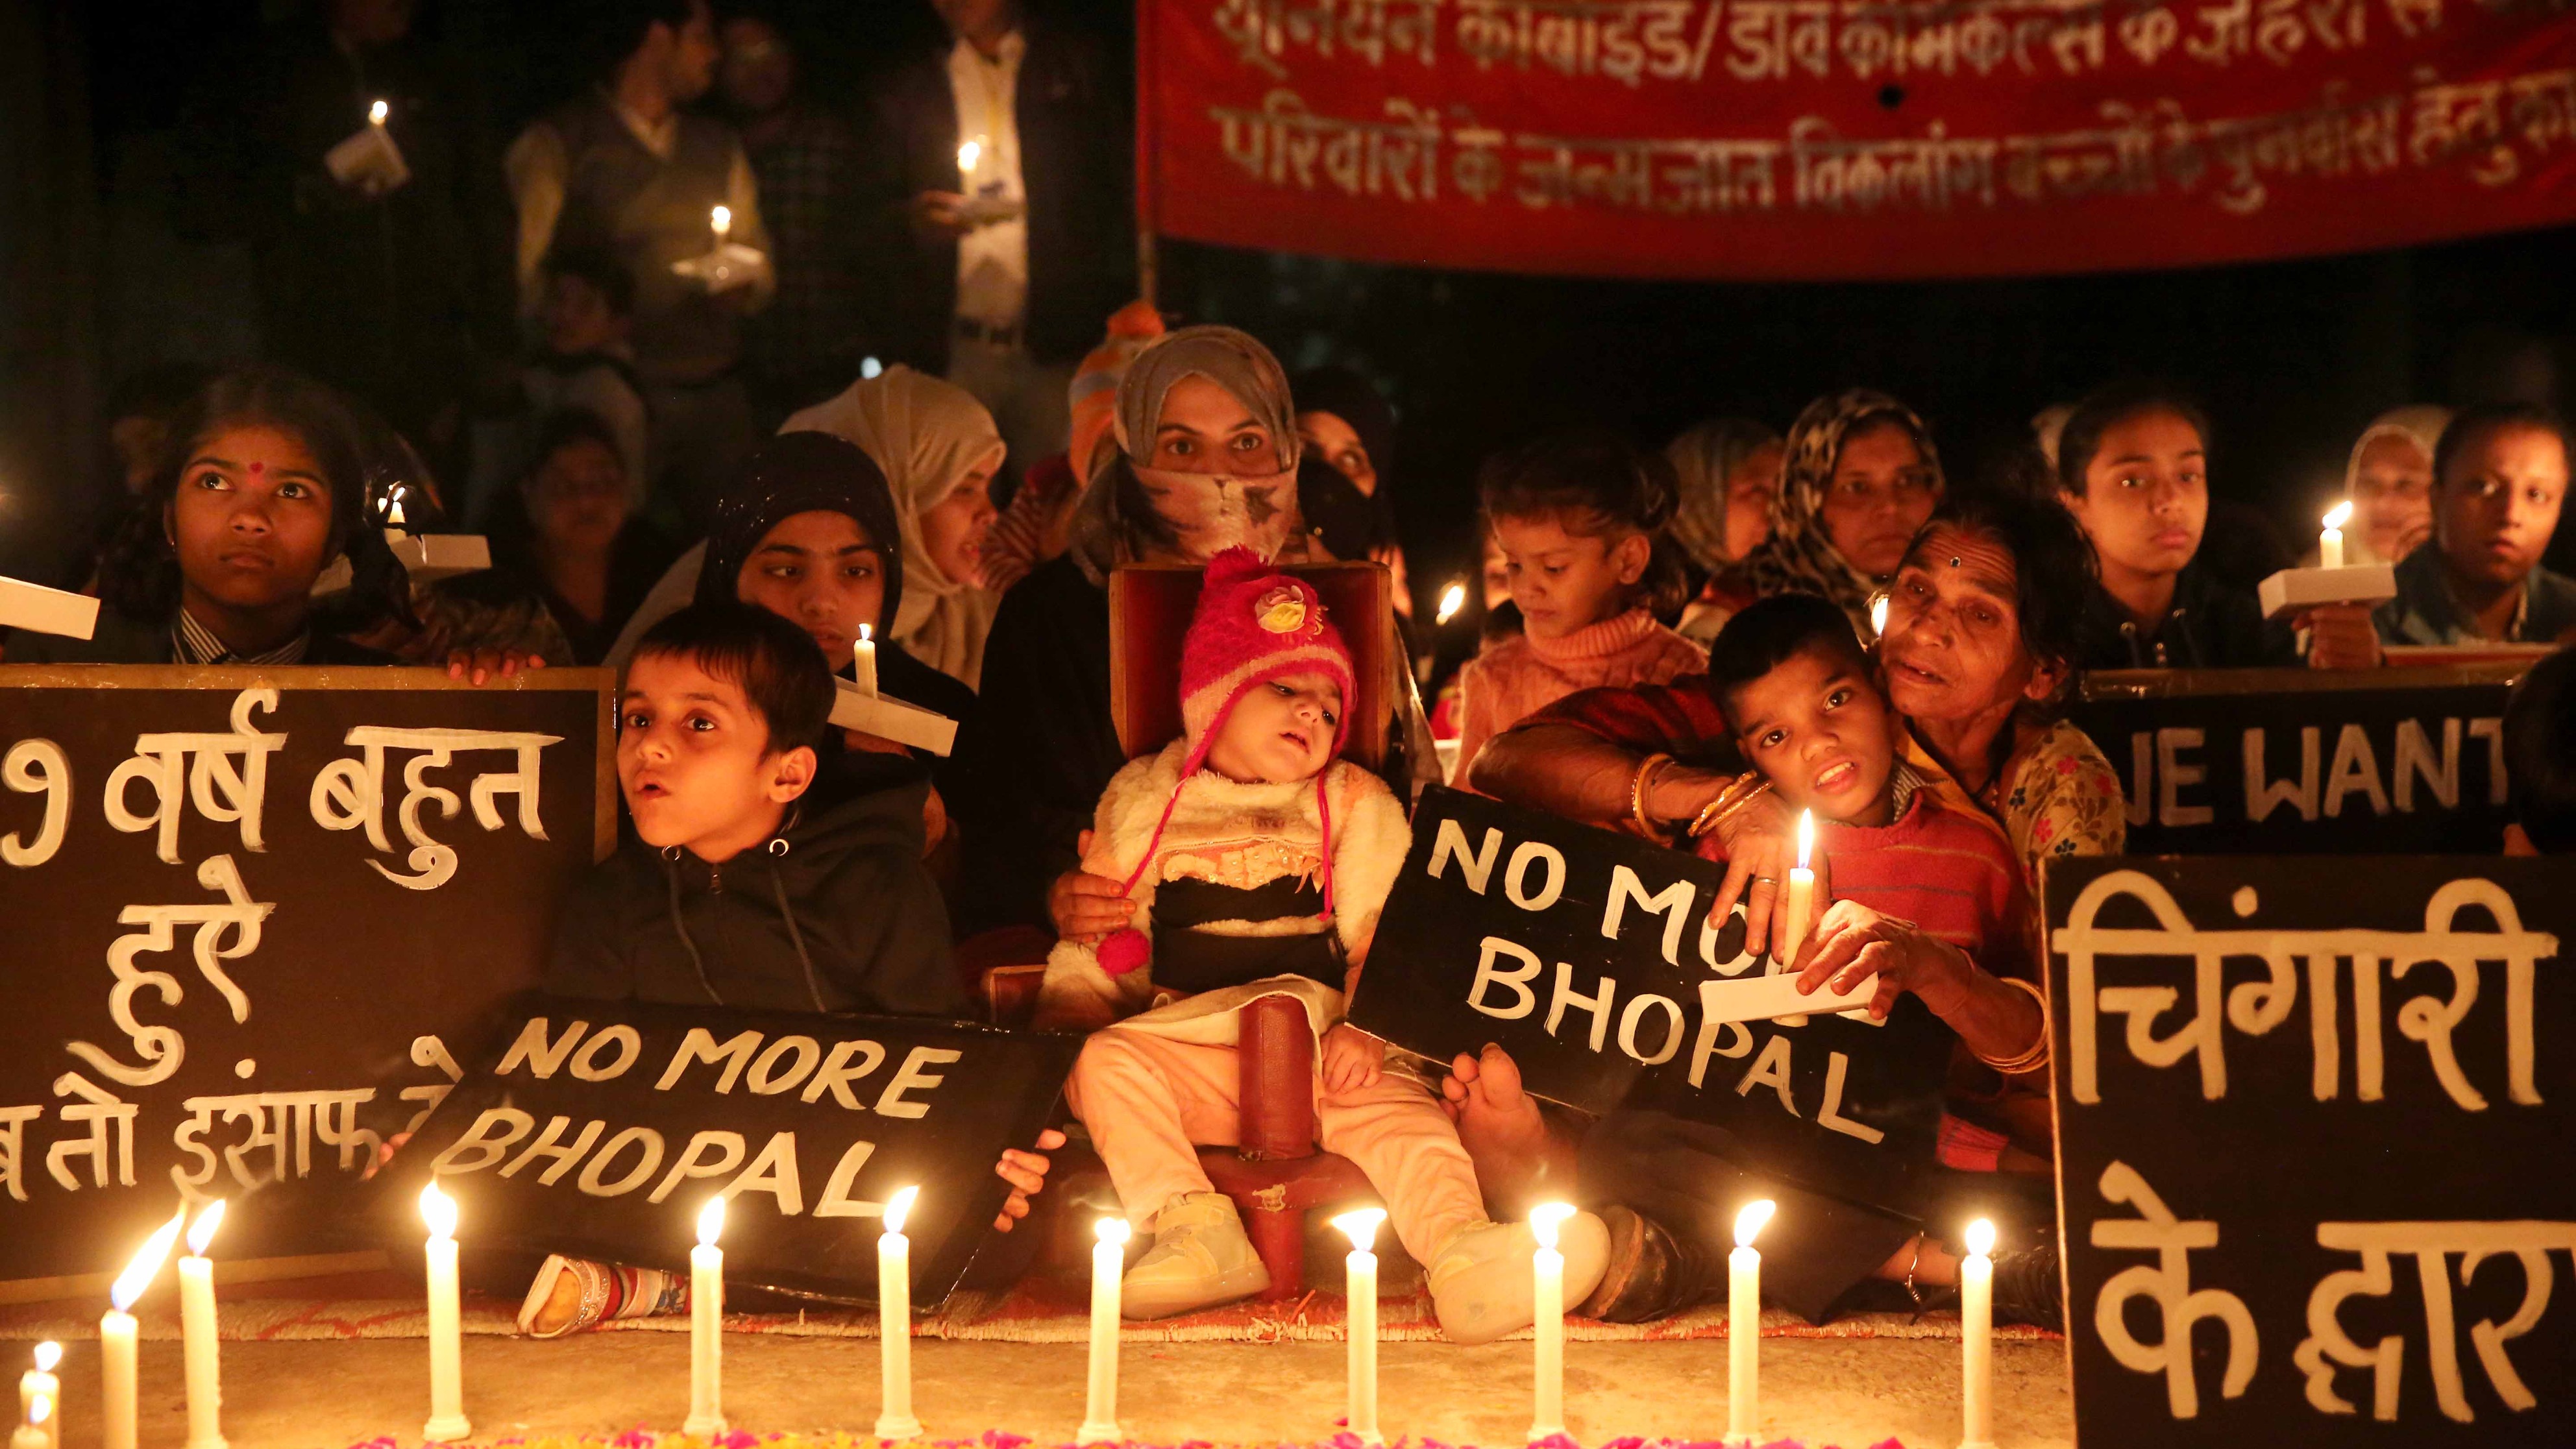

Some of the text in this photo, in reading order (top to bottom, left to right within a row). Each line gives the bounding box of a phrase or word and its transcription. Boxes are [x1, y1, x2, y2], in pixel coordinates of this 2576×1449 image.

[103, 688, 288, 864] वर्ष
[310, 725, 565, 890] बहुत
[2244, 717, 2509, 823] WANT
[1428, 819, 1566, 912] NO
[1466, 936, 1885, 1145] BHOPAL
[2052, 870, 2558, 1111] चिंगारी
[46, 1071, 140, 1191] तो
[170, 1058, 382, 1202] इंसाफ
[495, 1017, 962, 1119] NO MORE
[431, 1107, 892, 1219] BHOPAL
[2090, 1160, 2576, 1423] के द्वार
